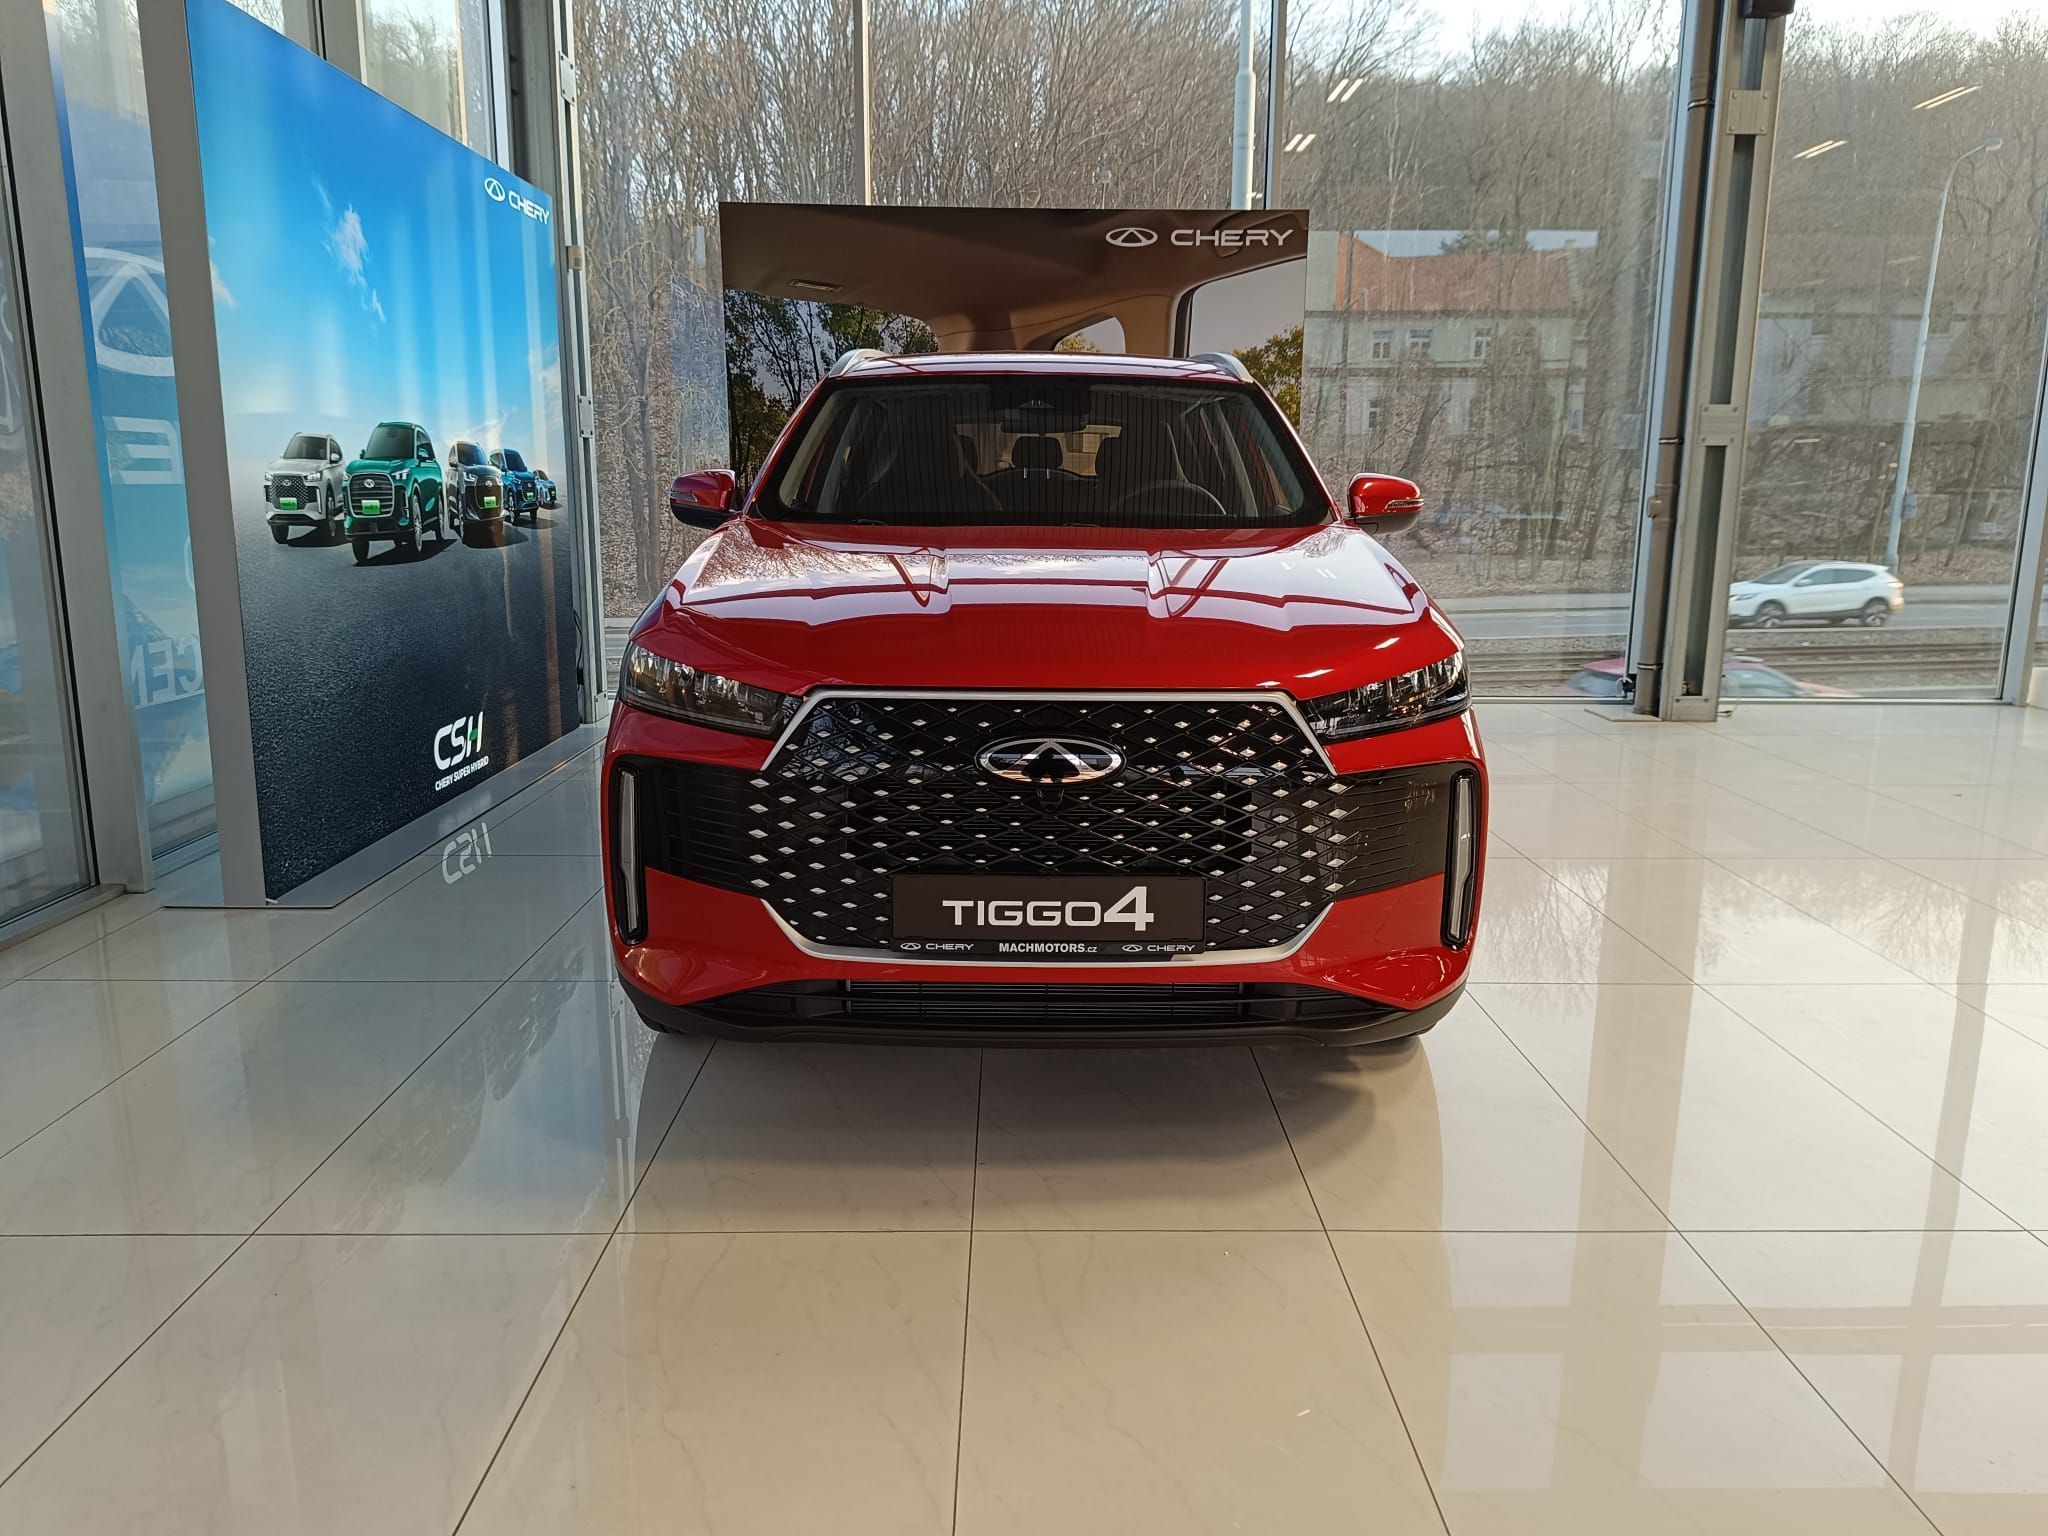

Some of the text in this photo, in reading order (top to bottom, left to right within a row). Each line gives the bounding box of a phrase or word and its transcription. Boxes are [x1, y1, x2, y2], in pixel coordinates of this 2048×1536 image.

[508, 190, 550, 225] CHERY
[1170, 229, 1294, 247] CHERY
[433, 711, 484, 771] CSH
[435, 755, 490, 792] CHERY SUPER HYBRID
[925, 942, 1196, 954] CHERY MACHMOTORS.cz CHERY
